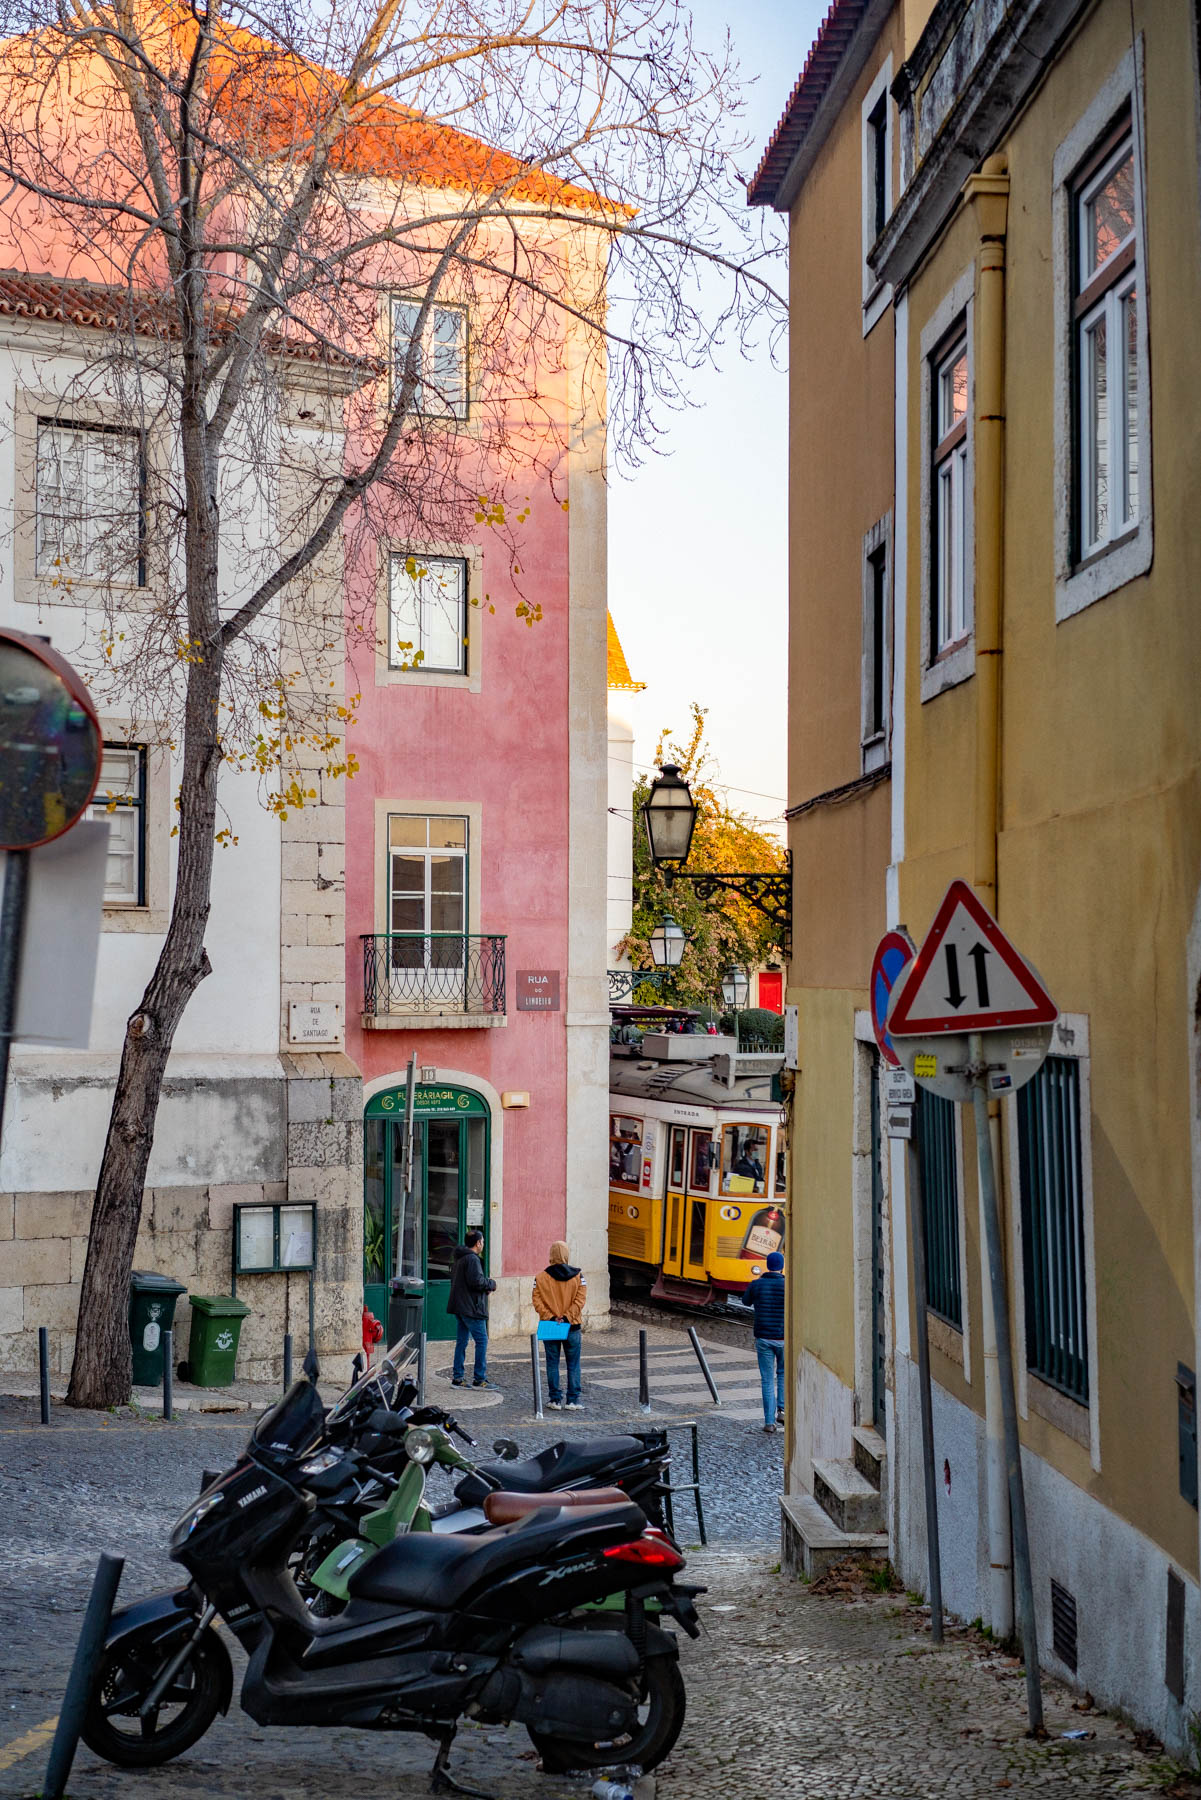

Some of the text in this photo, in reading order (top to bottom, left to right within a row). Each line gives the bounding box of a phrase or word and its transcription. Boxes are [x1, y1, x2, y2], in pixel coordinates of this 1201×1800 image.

[527, 975, 549, 984] RUA
[312, 1018, 319, 1026] DE
[302, 1029, 329, 1037] SANTIAGO
[397, 1090, 454, 1100] FUERÁRIAGIL
[674, 1109, 700, 1117] ENTRADA
[237, 1485, 268, 1508] YAMAHA
[226, 1603, 251, 1618] YAMAHA
